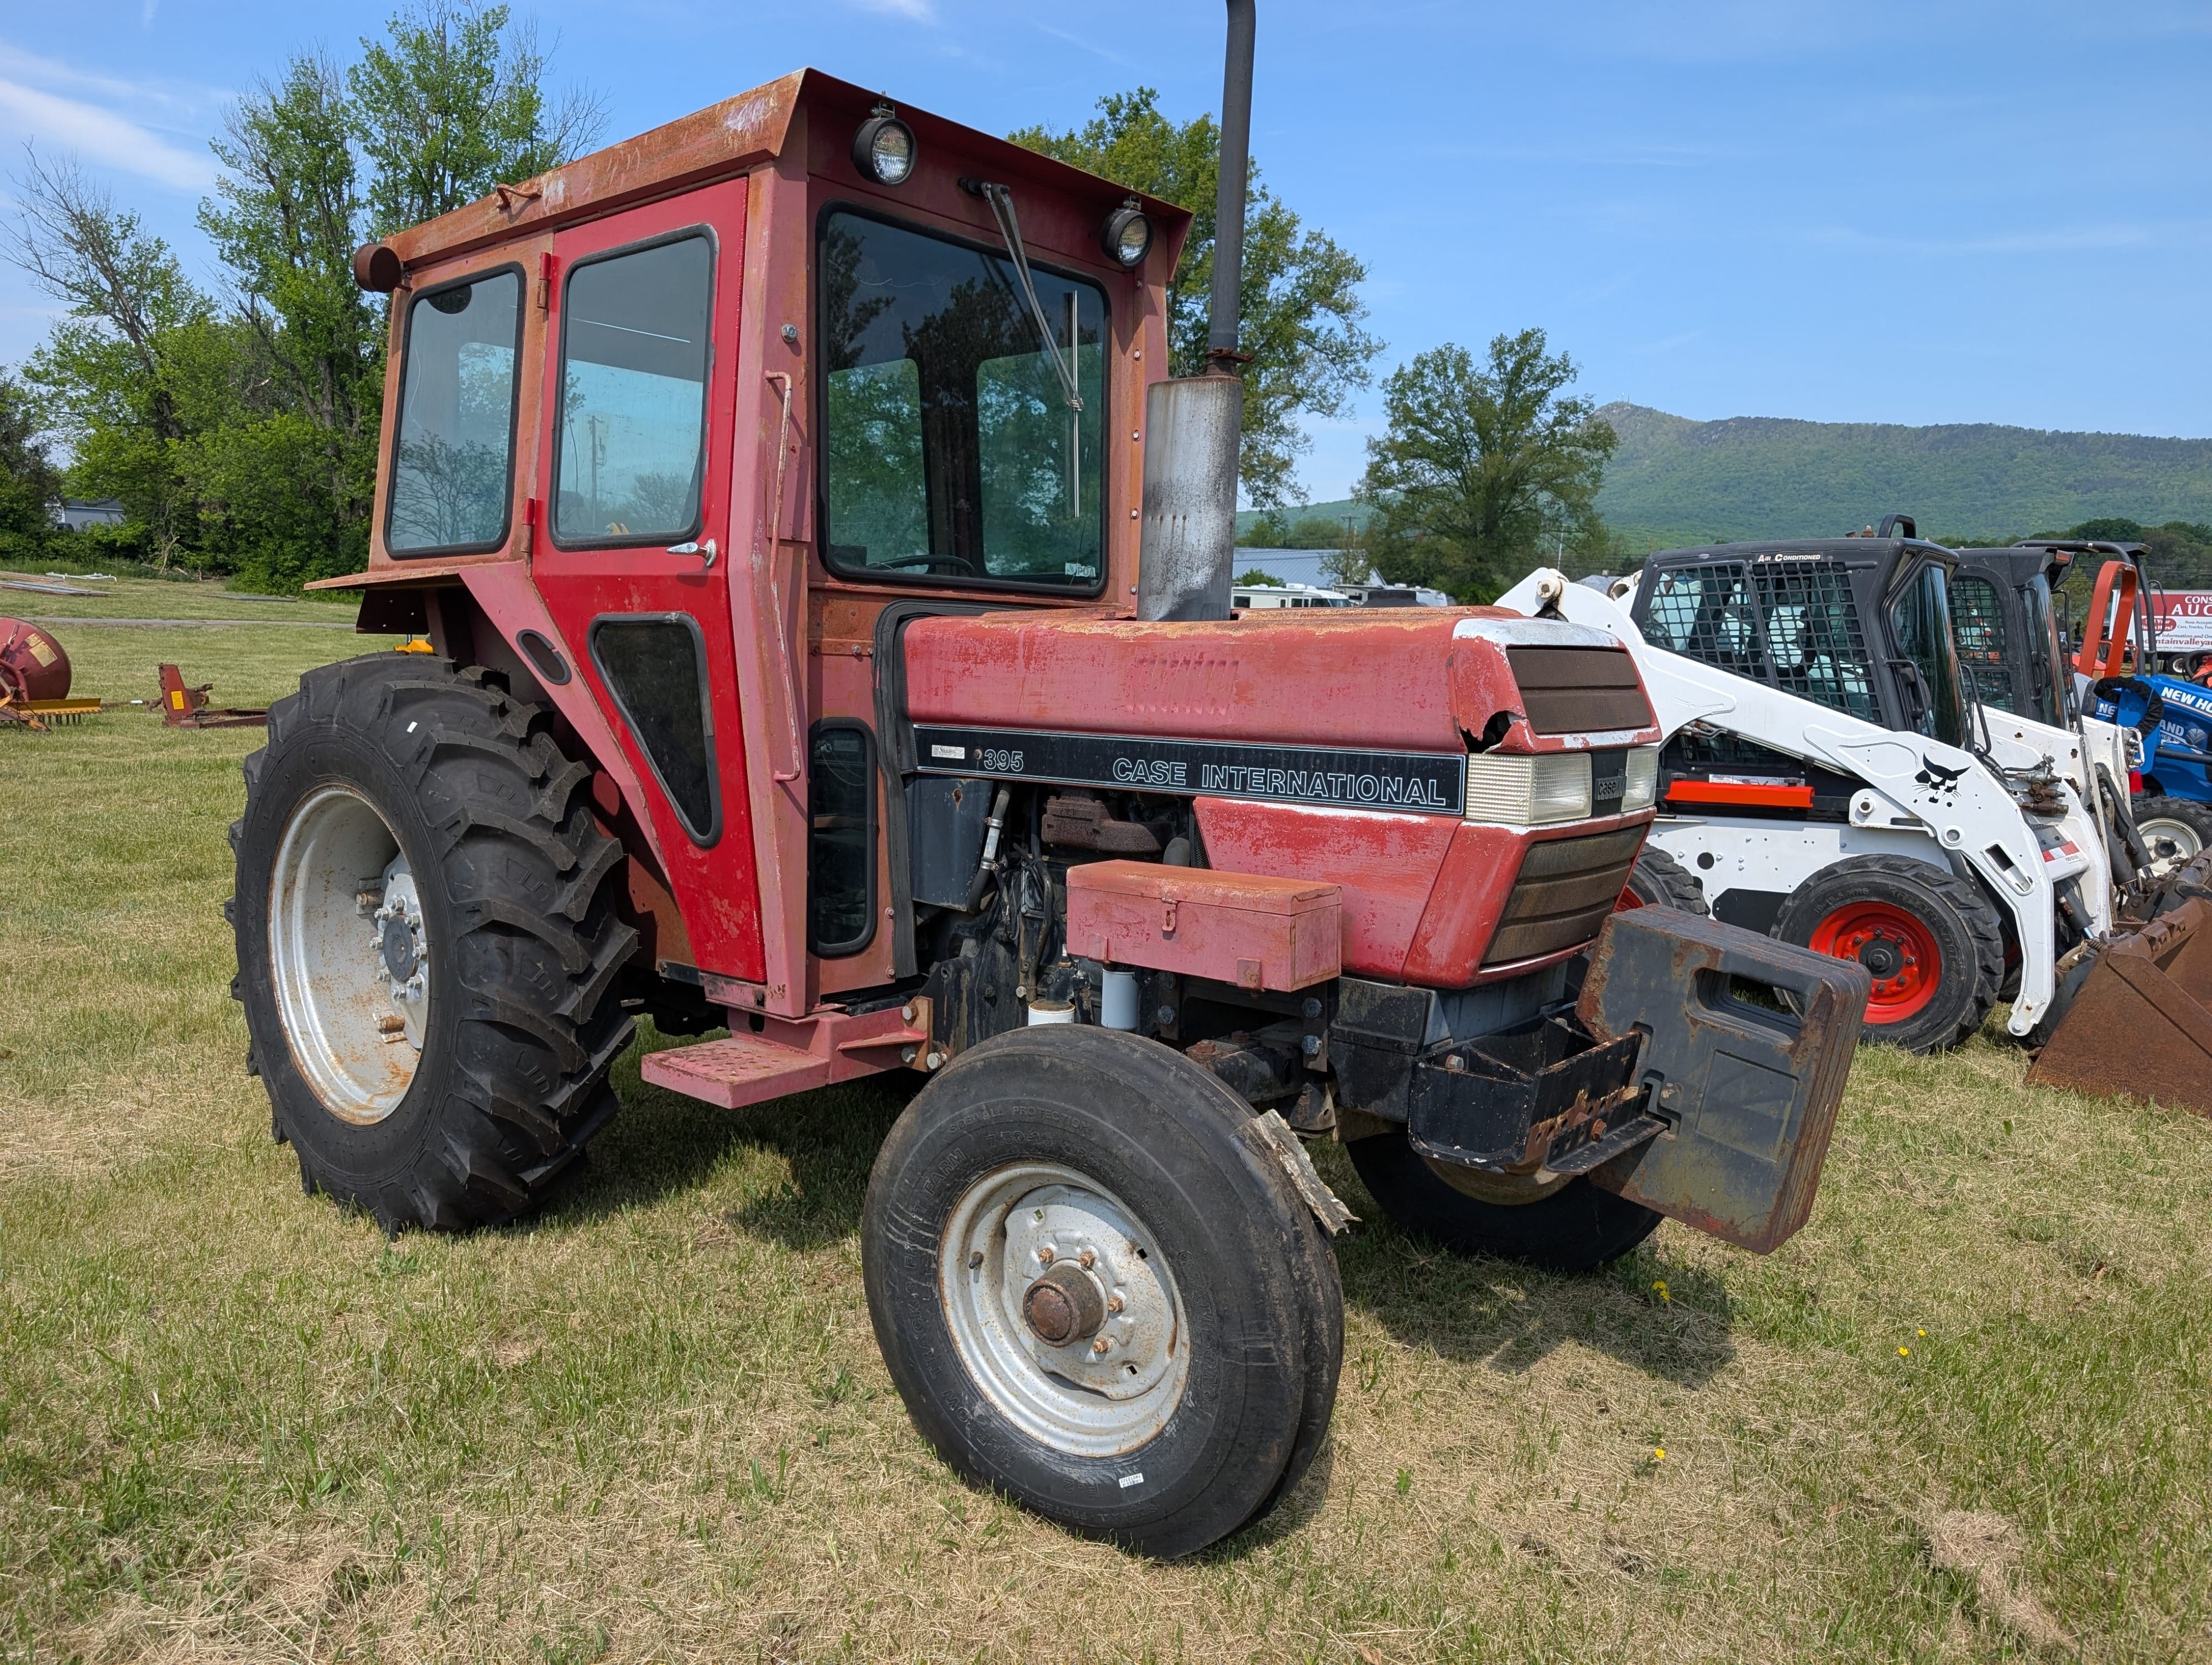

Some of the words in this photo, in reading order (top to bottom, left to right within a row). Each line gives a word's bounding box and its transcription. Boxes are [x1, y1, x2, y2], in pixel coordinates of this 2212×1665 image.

[2161, 687, 2195, 706] NEW
[2099, 703, 2117, 715] NE
[984, 749, 1024, 772] 395
[1113, 757, 1187, 786] CASE
[1201, 764, 1447, 806] INTERNATIONAL
[904, 1200, 927, 1270] FRONT
[923, 1147, 968, 1197] FARM
